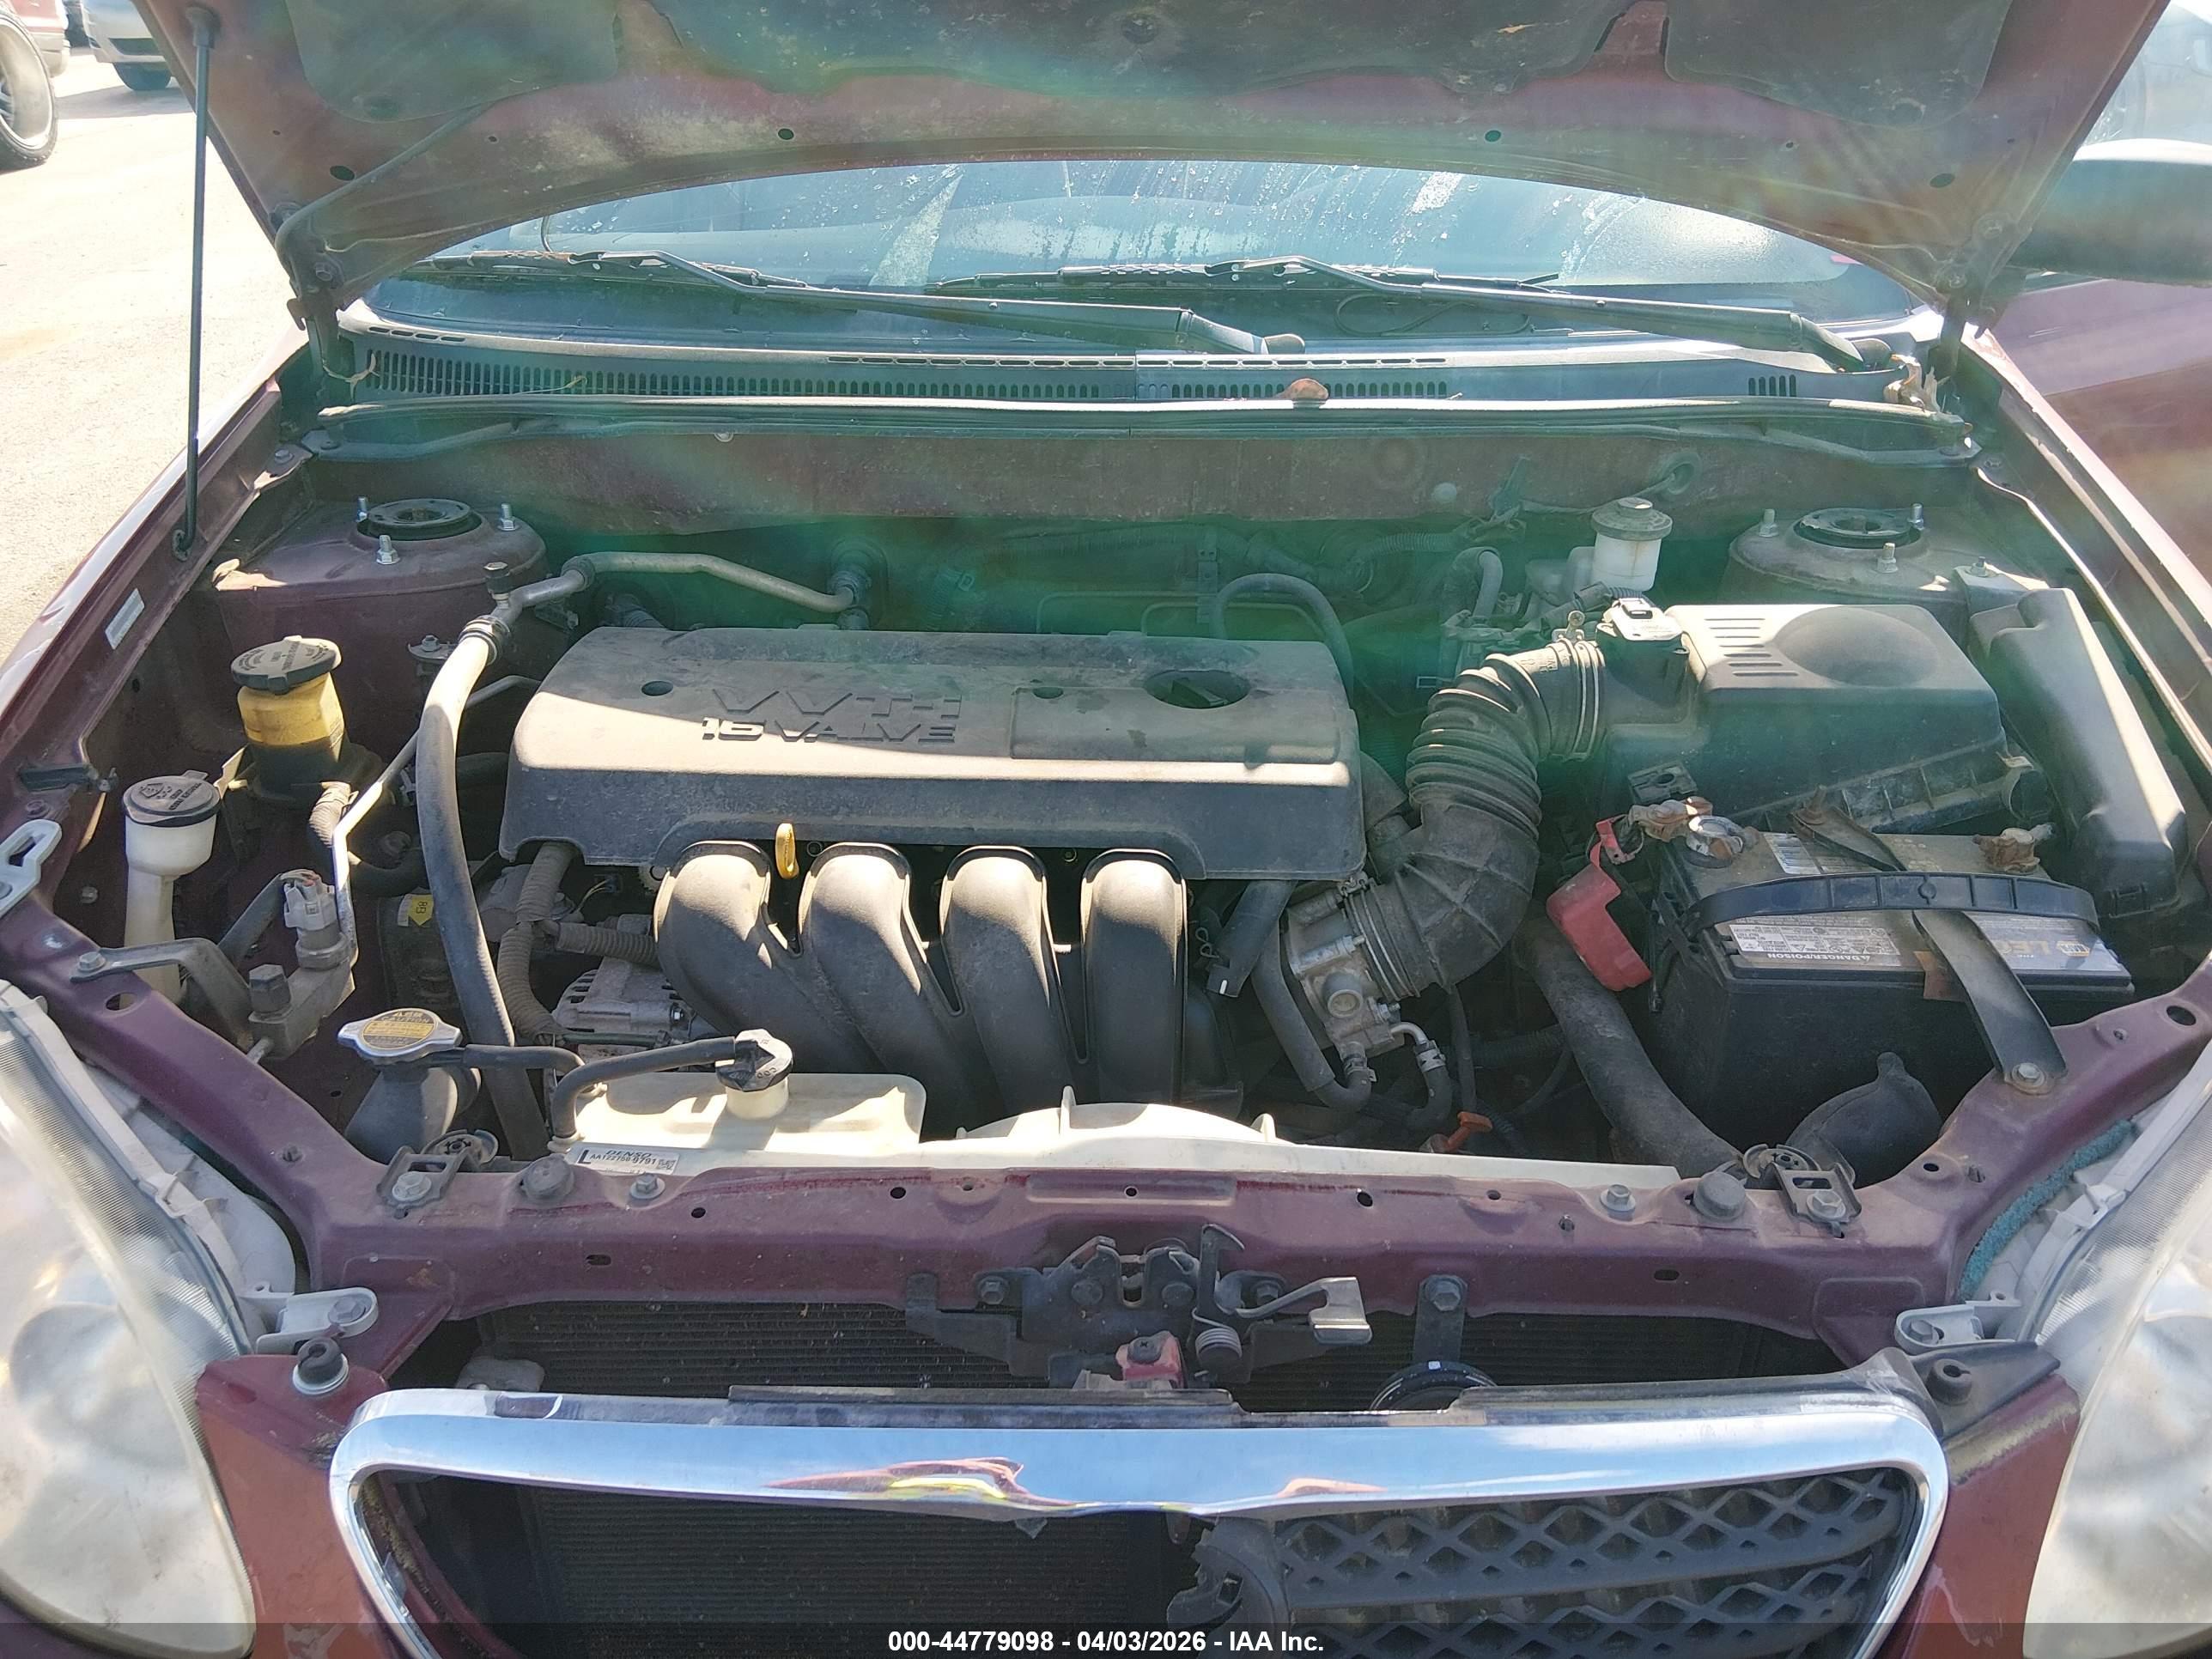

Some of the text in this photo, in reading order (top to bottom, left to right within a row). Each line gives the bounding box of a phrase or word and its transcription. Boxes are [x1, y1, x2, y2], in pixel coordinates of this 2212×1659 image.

[702, 717, 957, 743] 16 VALVE
[577, 1150, 591, 1164] L
[605, 1150, 652, 1158] DENSO
